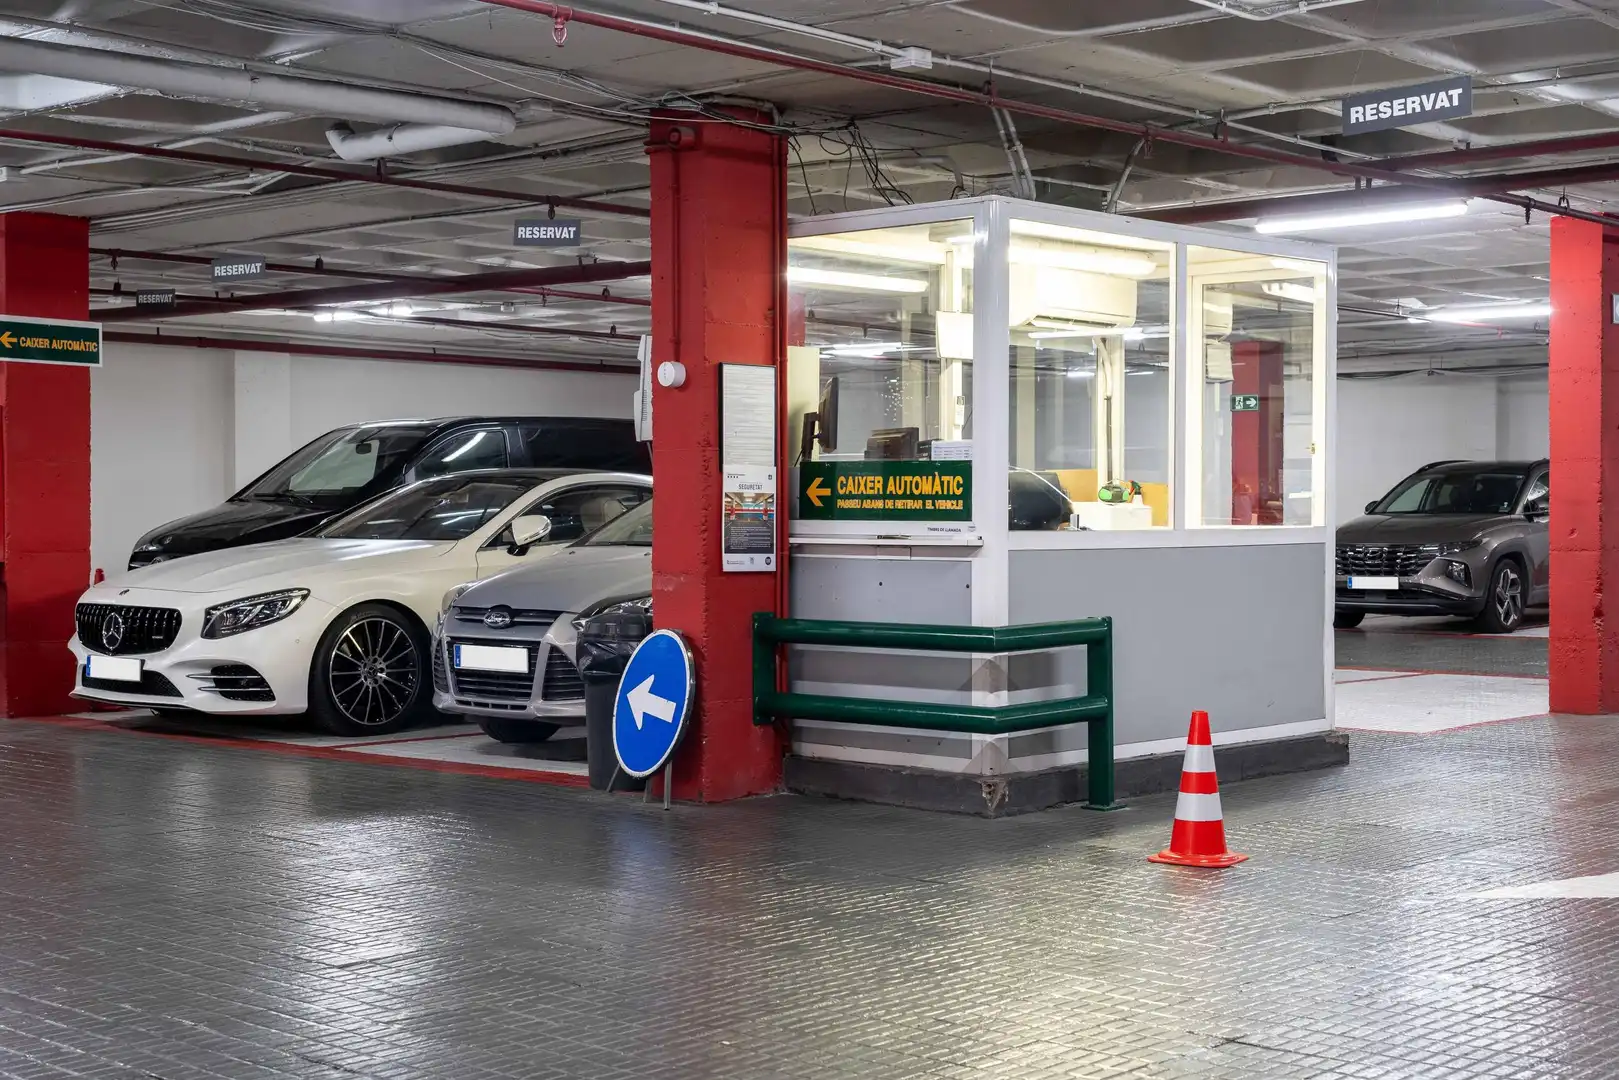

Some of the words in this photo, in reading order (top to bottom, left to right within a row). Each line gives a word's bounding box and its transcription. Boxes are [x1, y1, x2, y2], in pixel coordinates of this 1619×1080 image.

[1350, 88, 1463, 124] RESERVAT
[517, 226, 577, 239] RESERVAT
[214, 263, 262, 277] RESERVAT
[138, 294, 173, 304] RESERVAT
[20, 336, 50, 349] CAIXER
[51, 338, 98, 352] AUTOMÀTIC
[837, 475, 883, 495] CAIXER
[886, 472, 963, 495] AUTOMÀTIC
[837, 499, 860, 509] PASSEU
[862, 499, 883, 509] ABANS
[885, 499, 894, 509] DE
[895, 499, 923, 509] RETIRAR
[925, 499, 934, 509] EL
[935, 499, 963, 510] VEHICLE
